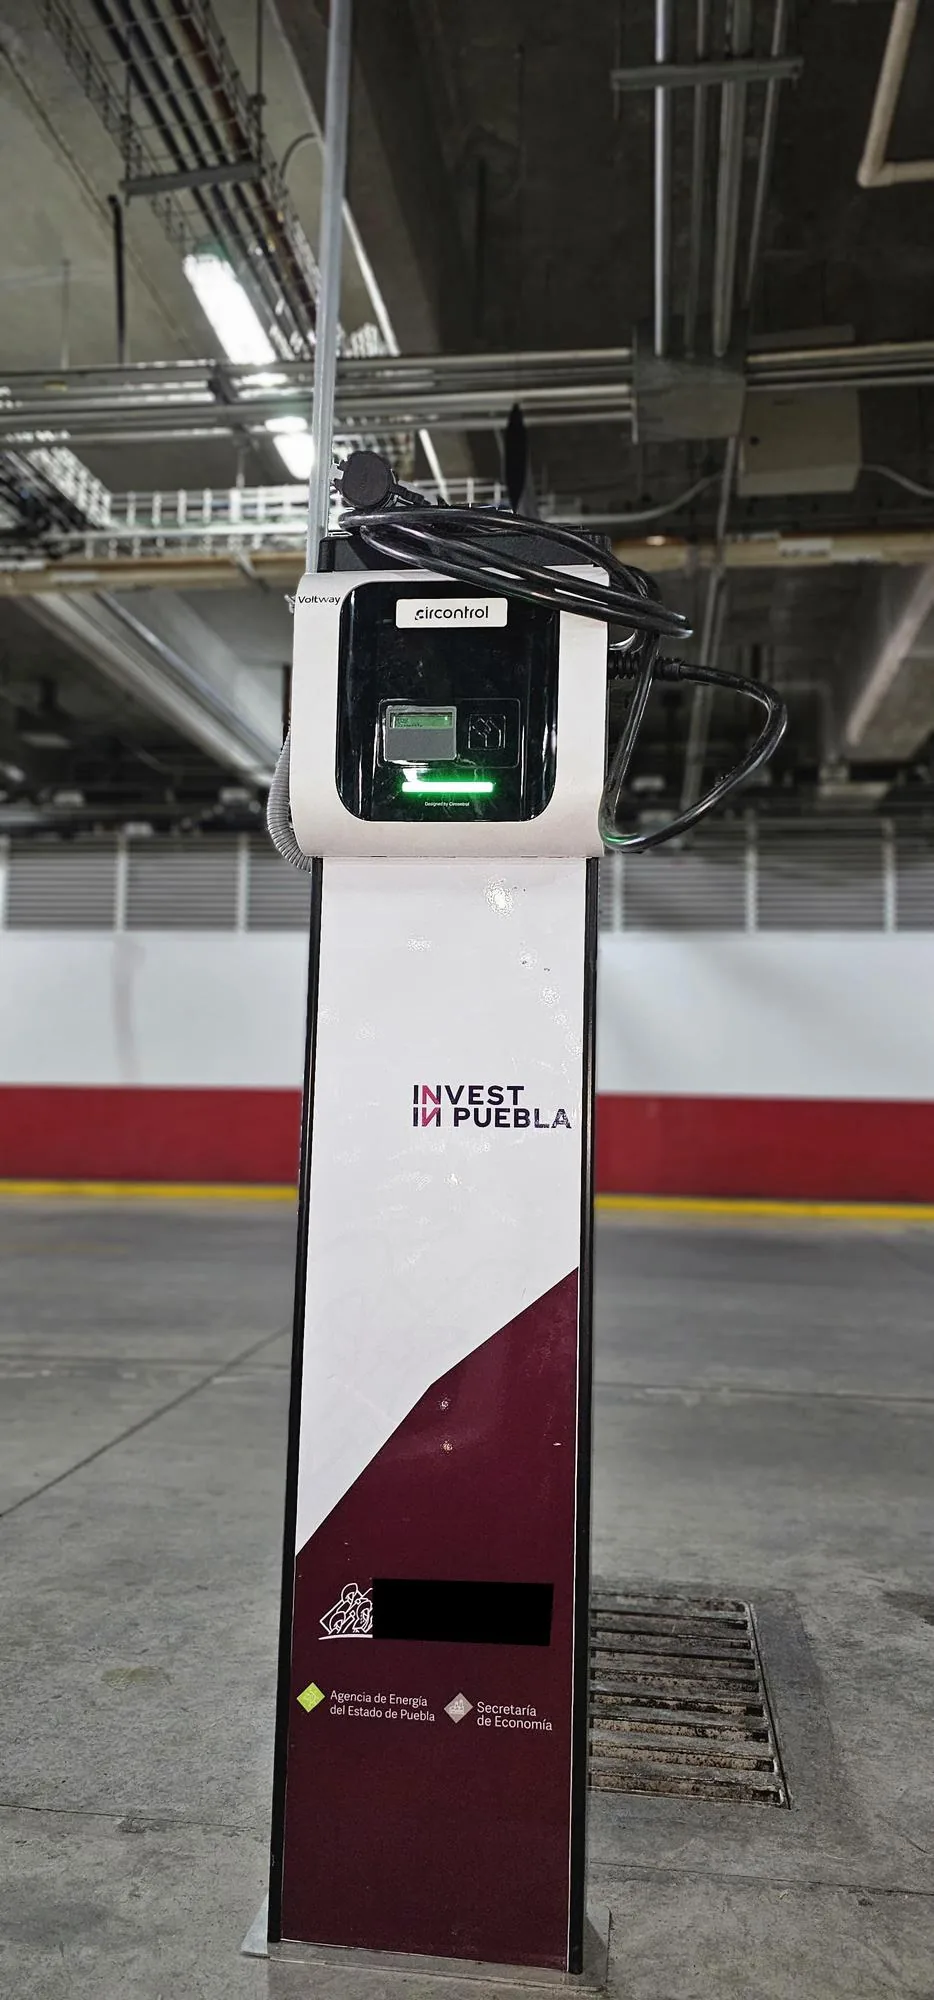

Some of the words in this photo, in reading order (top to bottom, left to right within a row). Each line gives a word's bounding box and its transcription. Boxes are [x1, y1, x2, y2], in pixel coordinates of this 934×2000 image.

[298, 595, 341, 606] Voltway
[414, 605, 489, 621] circontrol
[412, 1084, 525, 1106] INVEST
[453, 1107, 572, 1129] PUEBLA
[330, 1690, 372, 1704] Agencia
[374, 1692, 387, 1704] de
[389, 1693, 428, 1709] Energía
[329, 1704, 346, 1715] del
[348, 1705, 383, 1718] Estado
[384, 1708, 398, 1719] de
[400, 1708, 435, 1721] Puebla
[476, 1701, 537, 1717] Secretaría
[476, 1714, 492, 1727] de
[494, 1715, 553, 1731] Economía
